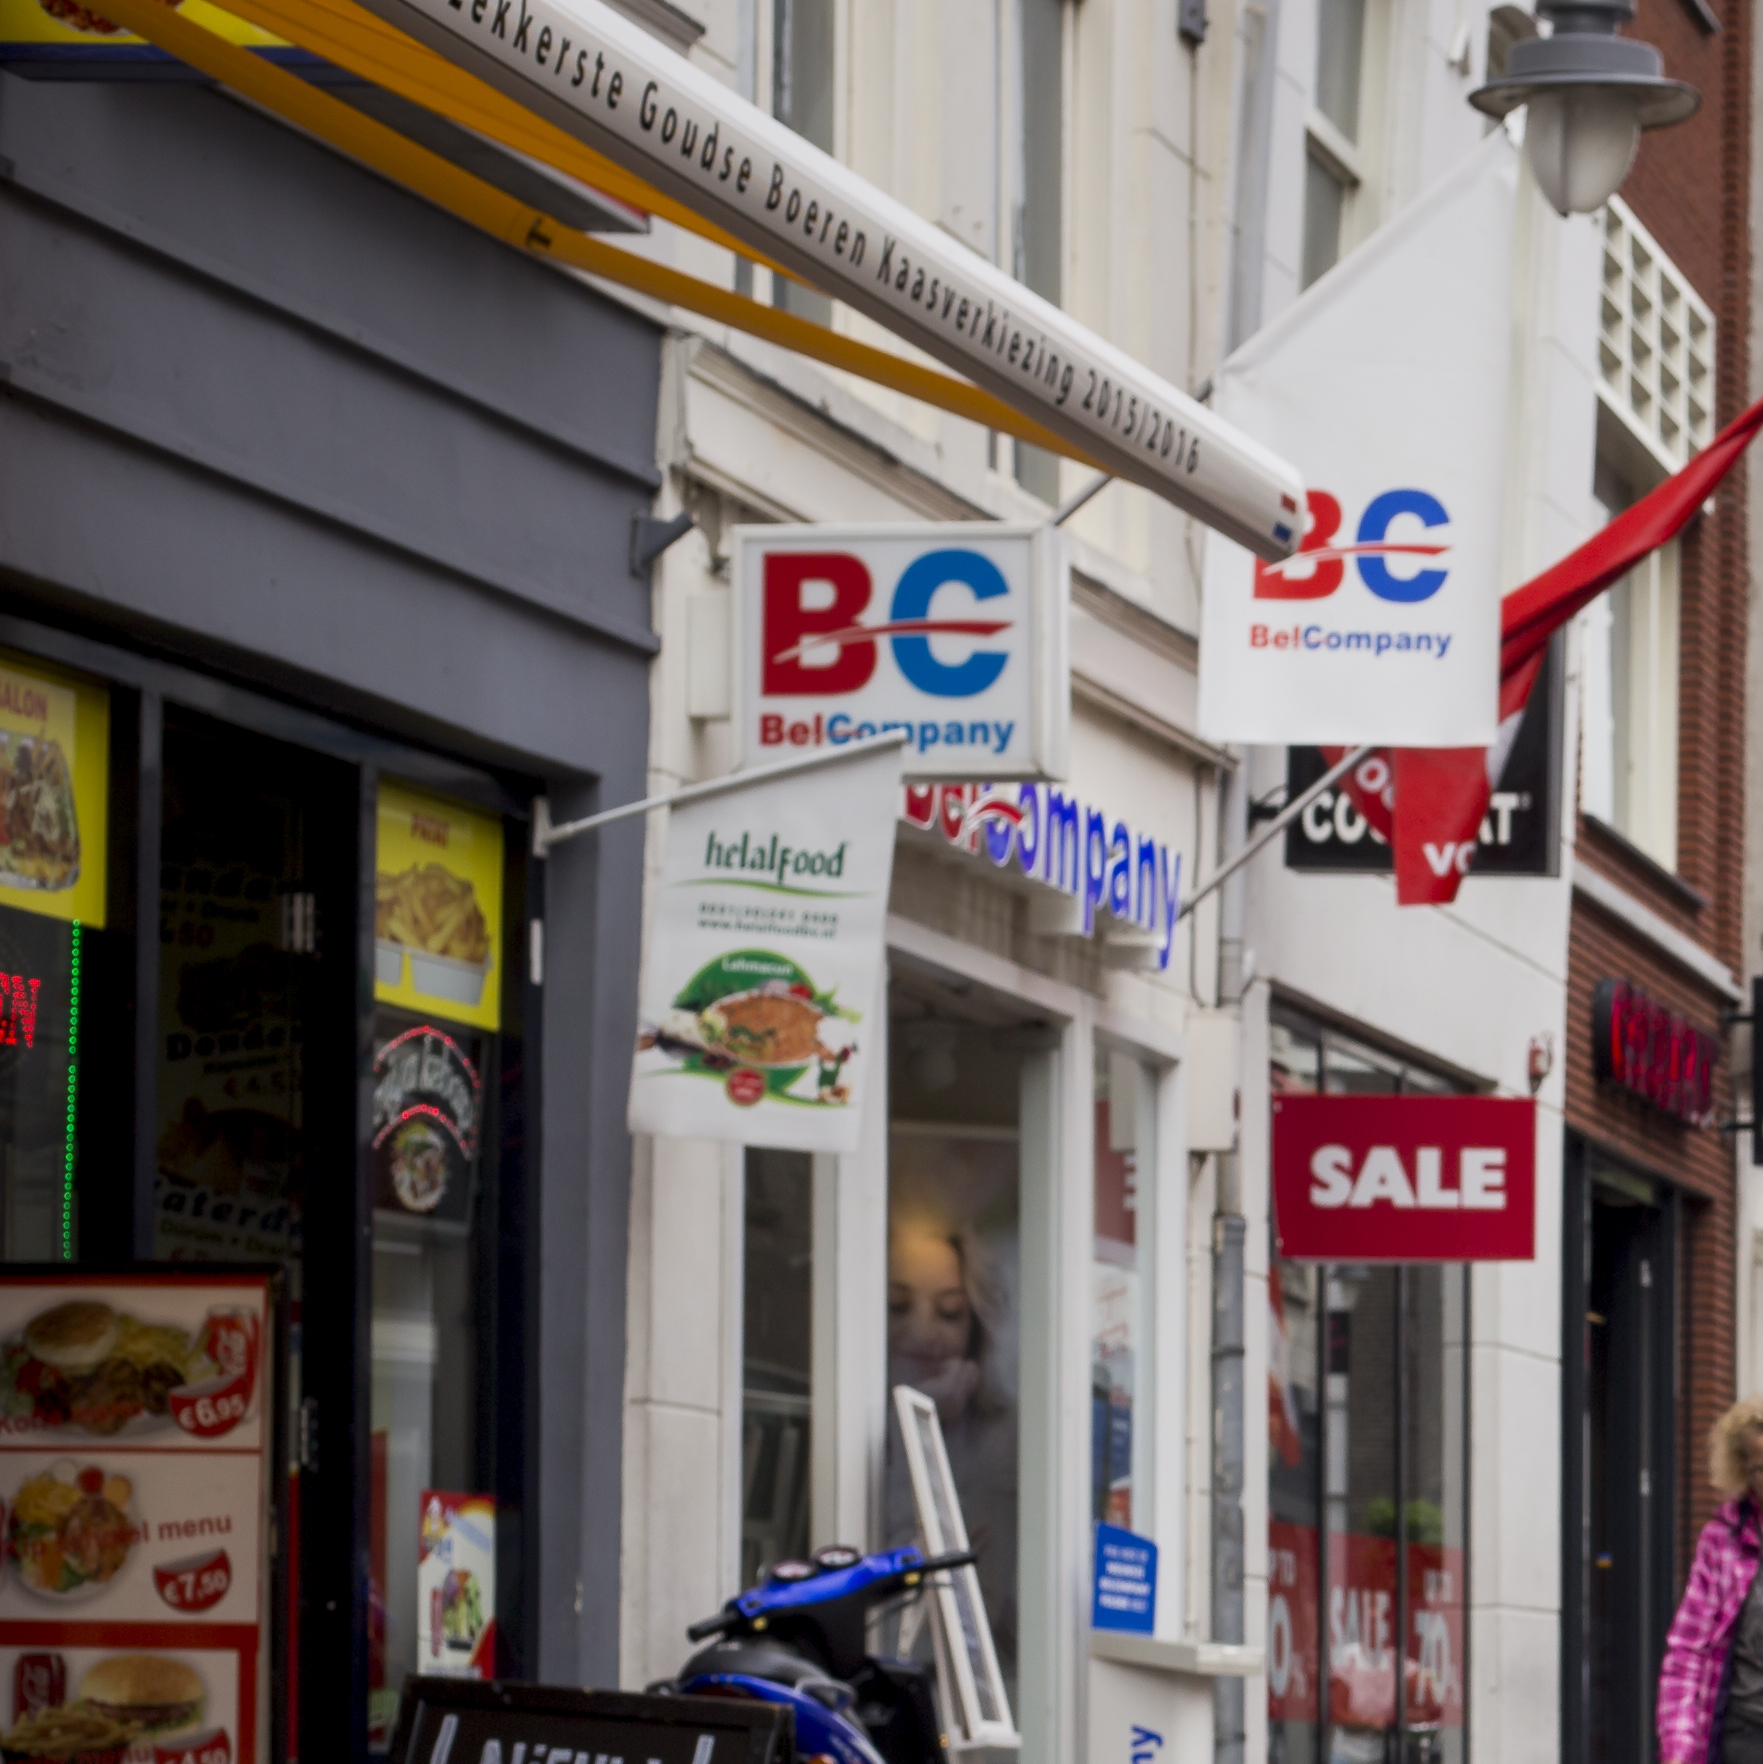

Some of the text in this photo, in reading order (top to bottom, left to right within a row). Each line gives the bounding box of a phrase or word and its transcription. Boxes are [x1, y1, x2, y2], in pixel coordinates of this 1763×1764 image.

[447, 0, 1200, 475] ekkerste Goudse Boeren Kaasverkiezing 2015/2016
[1252, 489, 1452, 604] BC
[760, 547, 1012, 698] BC
[1249, 624, 1452, 658] BelCompany
[759, 711, 1015, 755] BelCompany
[704, 831, 846, 886] helalfood
[1309, 1145, 1507, 1209] SALE
[158, 1515, 232, 1541] menu
